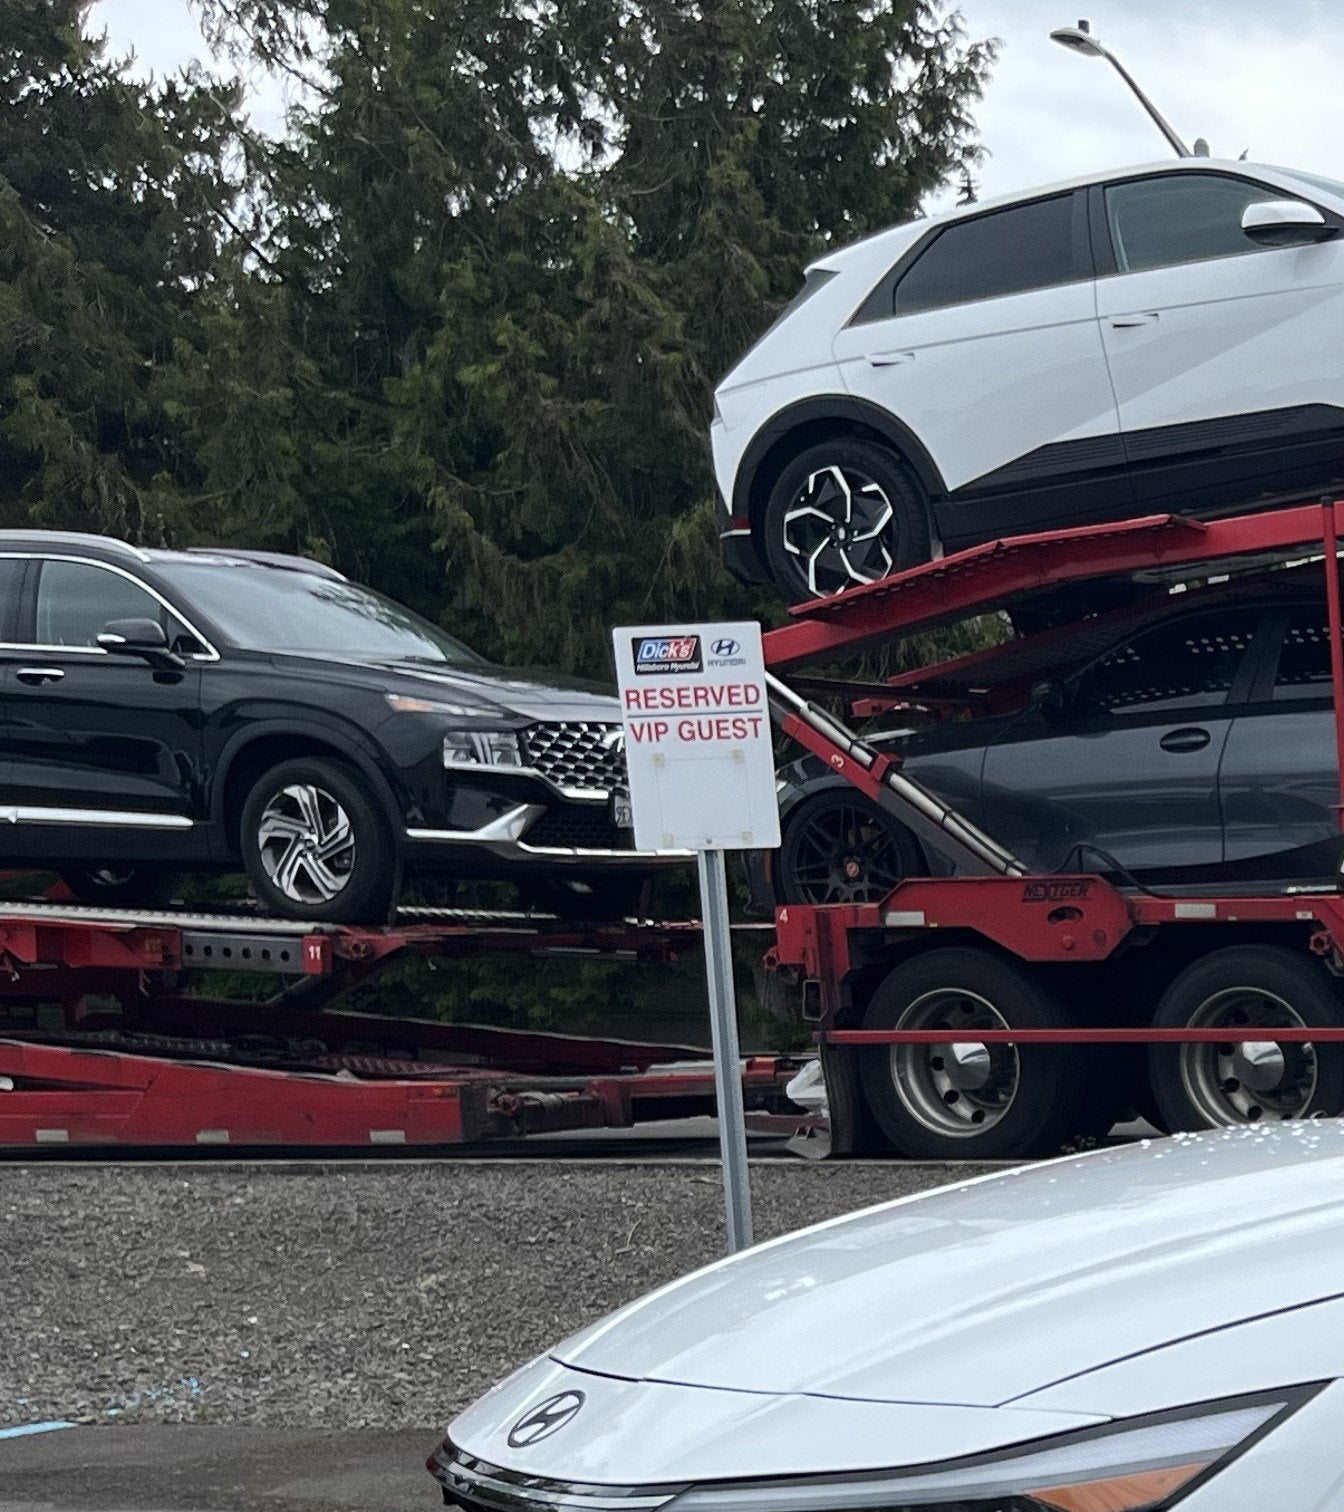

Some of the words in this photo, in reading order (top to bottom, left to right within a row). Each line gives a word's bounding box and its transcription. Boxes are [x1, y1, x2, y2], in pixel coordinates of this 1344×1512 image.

[625, 684, 761, 710] RESERVED
[630, 721, 669, 744] VIP
[678, 717, 763, 742] GUEST
[308, 944, 321, 961] 11
